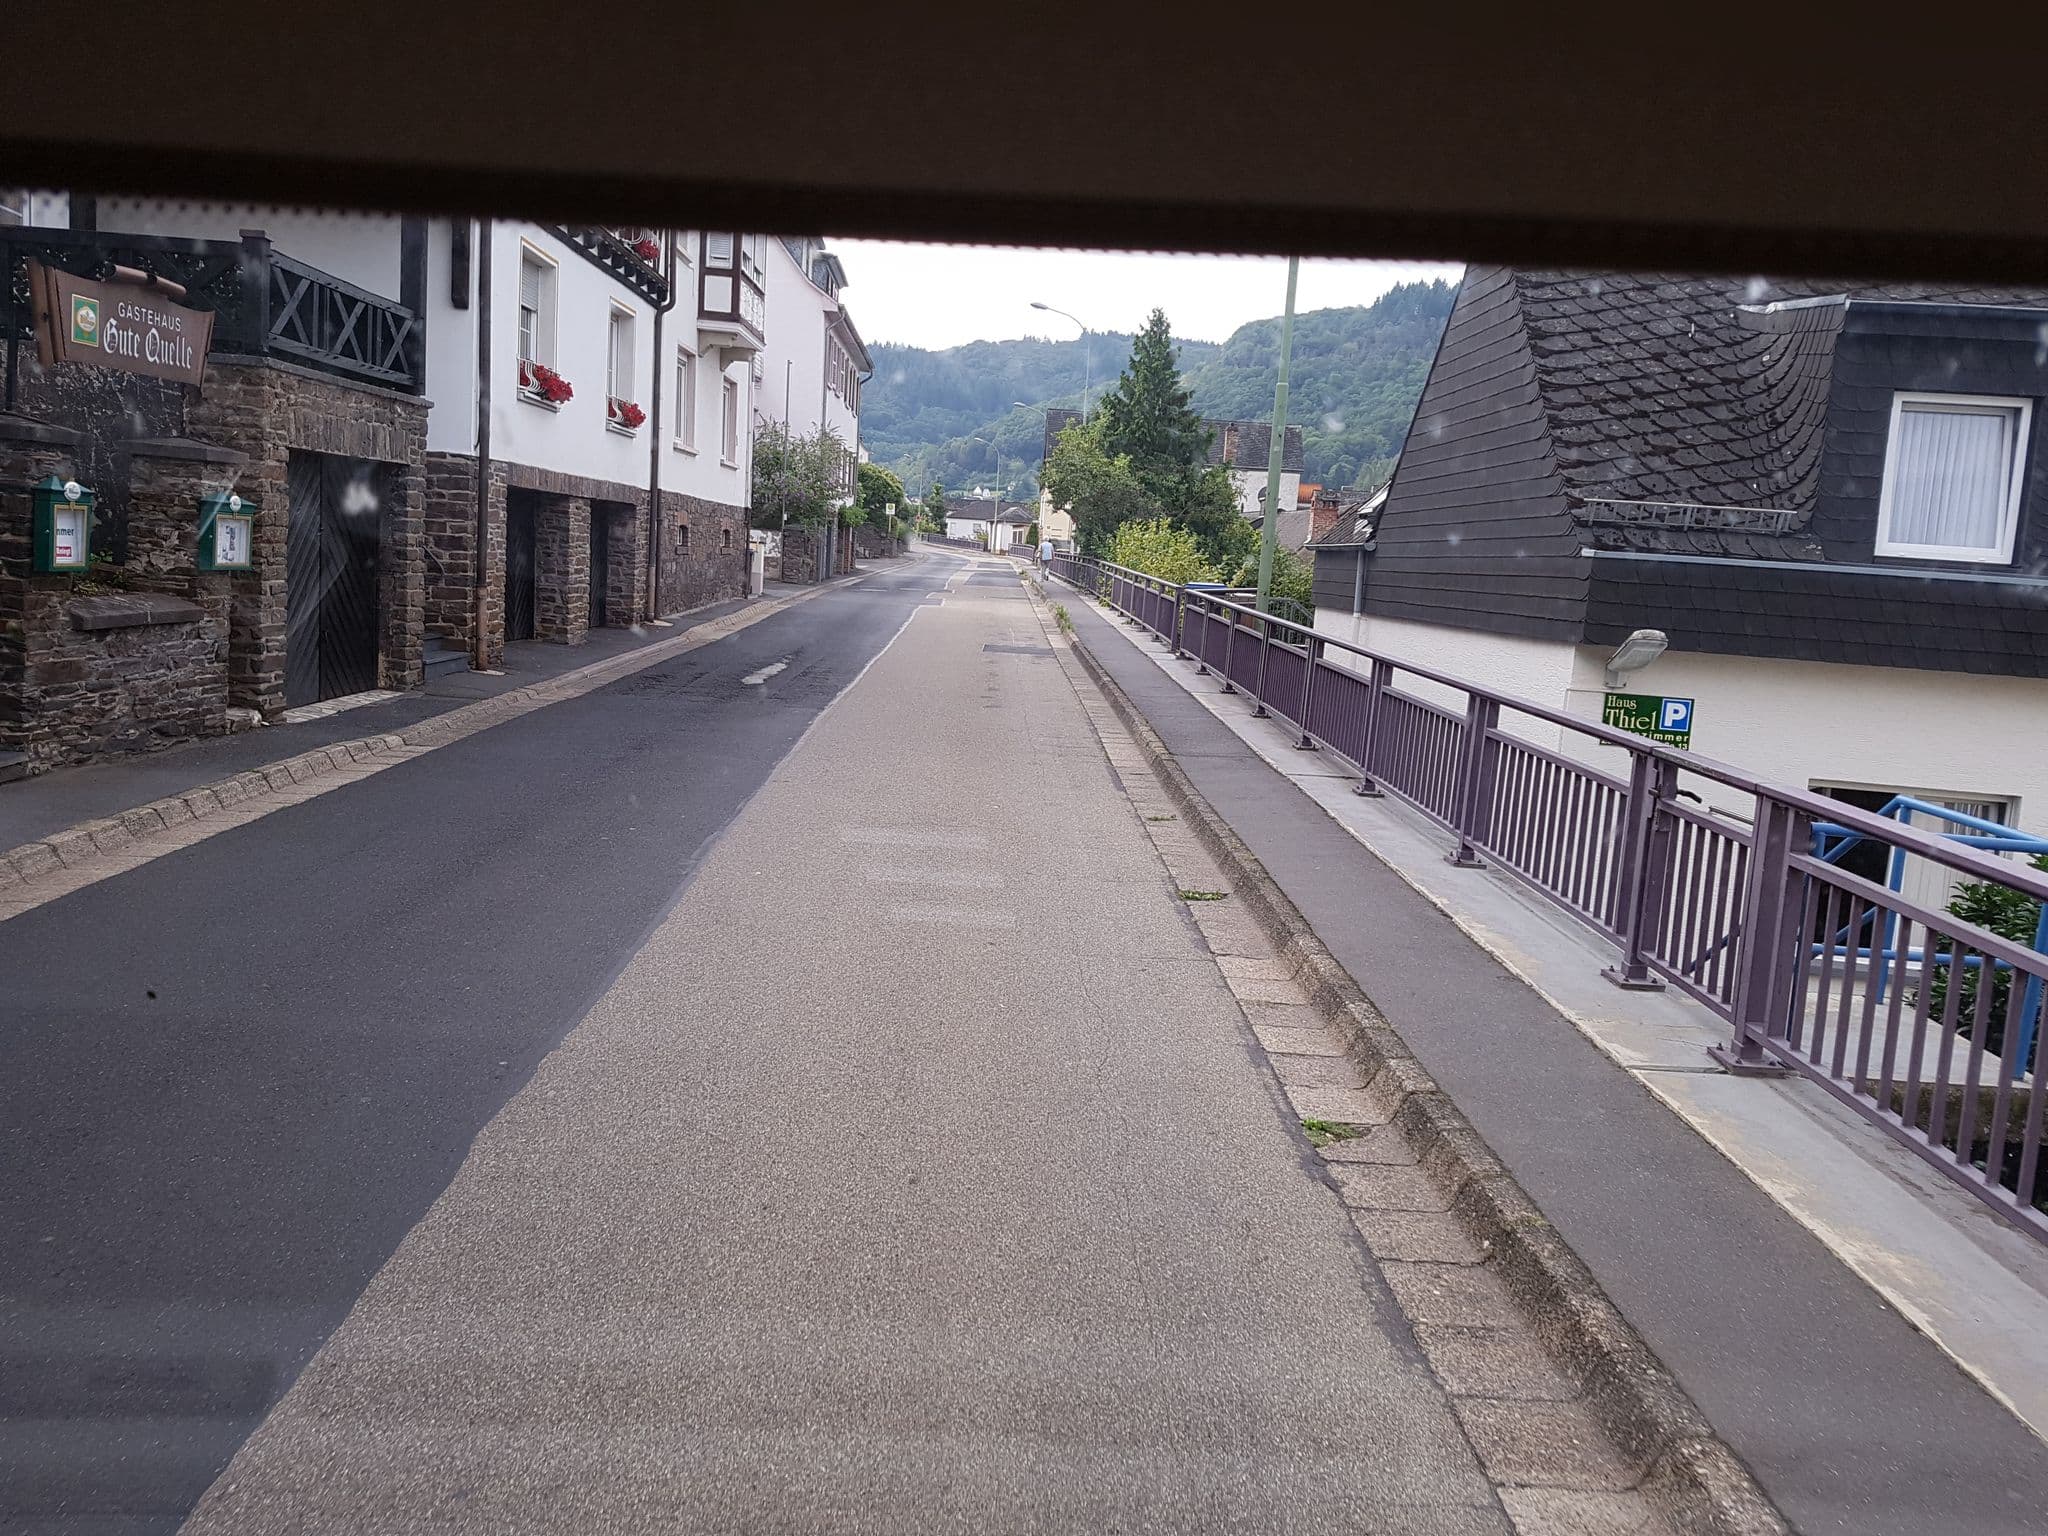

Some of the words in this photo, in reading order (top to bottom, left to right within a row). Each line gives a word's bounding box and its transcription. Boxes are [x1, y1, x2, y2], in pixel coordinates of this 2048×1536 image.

[118, 301, 181, 332] GÄSTEHAUS
[103, 318, 140, 358] Gute
[145, 328, 192, 369] Quelle
[1608, 695, 1637, 710] Haus
[1664, 702, 1687, 727] P
[1606, 709, 1657, 730] Thiel
